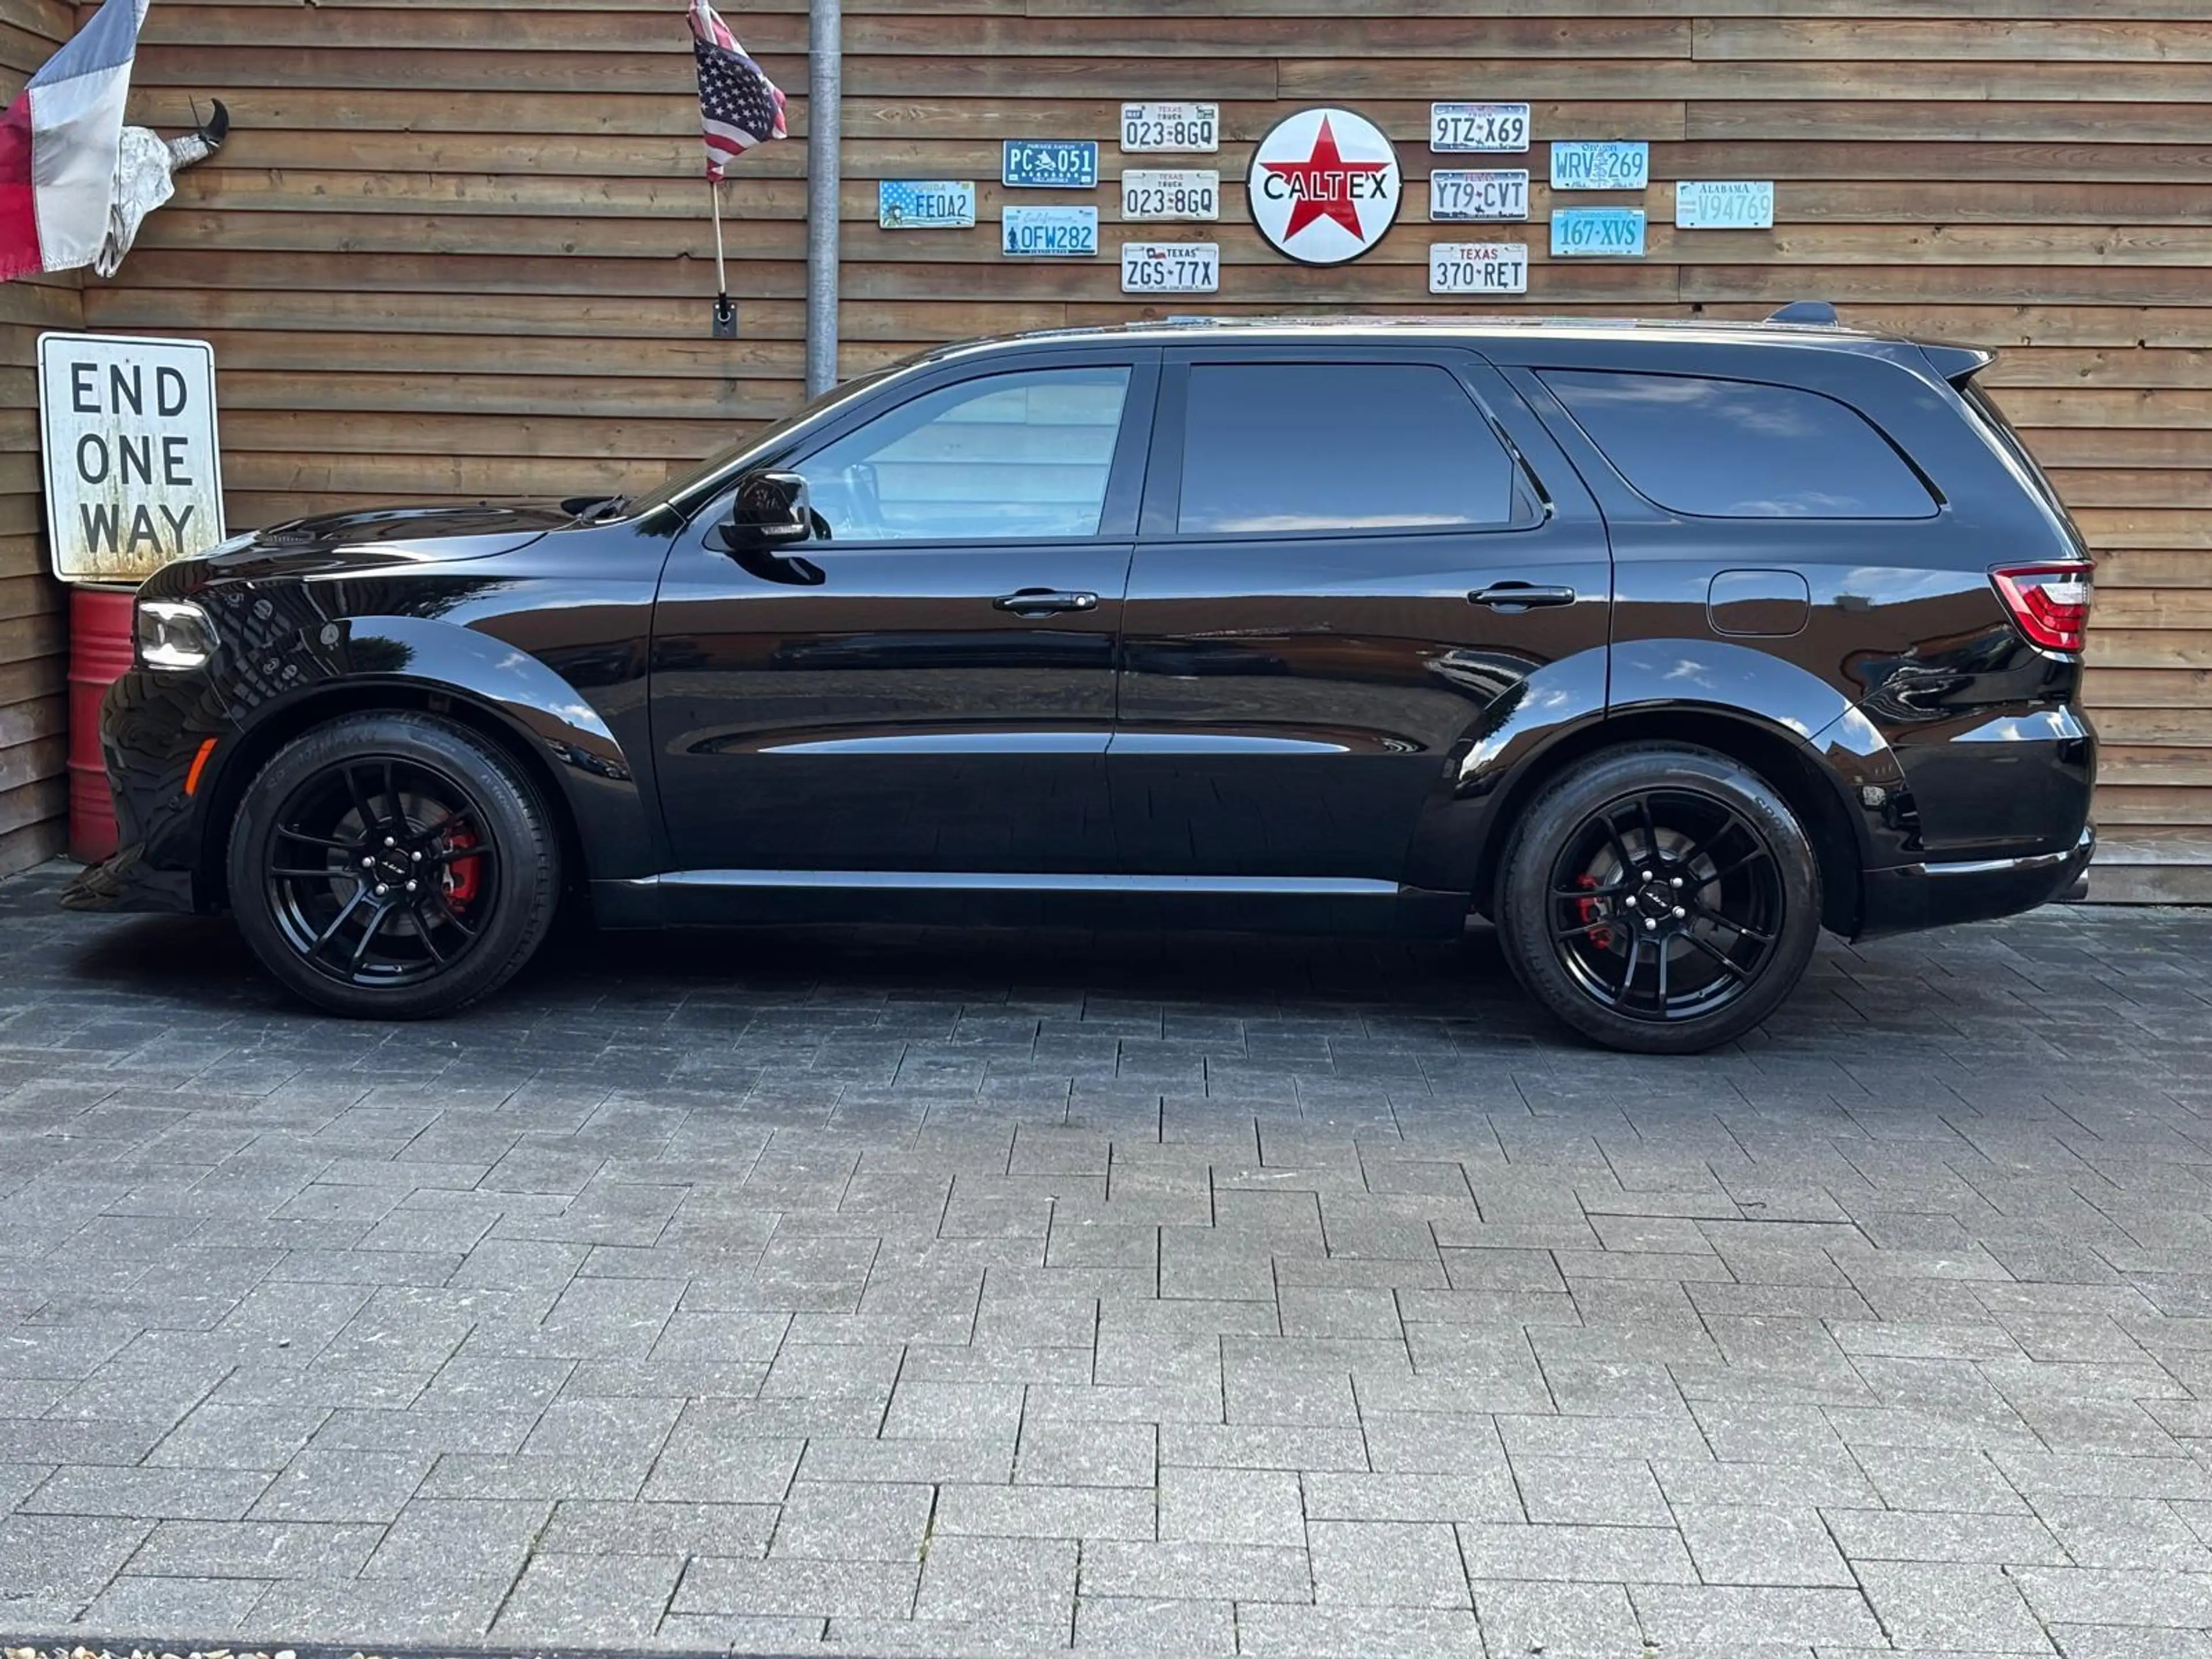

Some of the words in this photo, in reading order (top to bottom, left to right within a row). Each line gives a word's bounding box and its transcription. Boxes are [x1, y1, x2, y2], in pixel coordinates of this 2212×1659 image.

[1127, 122, 1164, 145] 023
[1174, 121, 1212, 145] 8GQ
[1437, 118, 1475, 142] 9TZ
[1485, 118, 1523, 142] X69
[1010, 149, 1033, 171] PC
[1058, 150, 1092, 172] 051
[1556, 152, 1594, 178] WRV
[1608, 152, 1643, 178] 269
[1263, 173, 1388, 200] CALTEX
[1437, 182, 1475, 209] Y79
[1484, 182, 1523, 208] CVT
[1700, 184, 1750, 194] ALABAMA
[1127, 189, 1164, 213] 023
[1175, 188, 1212, 213] 8GQ
[1698, 195, 1771, 220] V94769
[1166, 248, 1196, 257] TEXAS
[1460, 248, 1498, 260] TEXAS
[1127, 261, 1164, 285] ZGS
[1175, 261, 1212, 285] 77X
[1437, 262, 1474, 286] 370
[1484, 262, 1522, 286] RET
[70, 362, 187, 417] END
[76, 433, 193, 486] ONE
[79, 502, 195, 554] WAY
